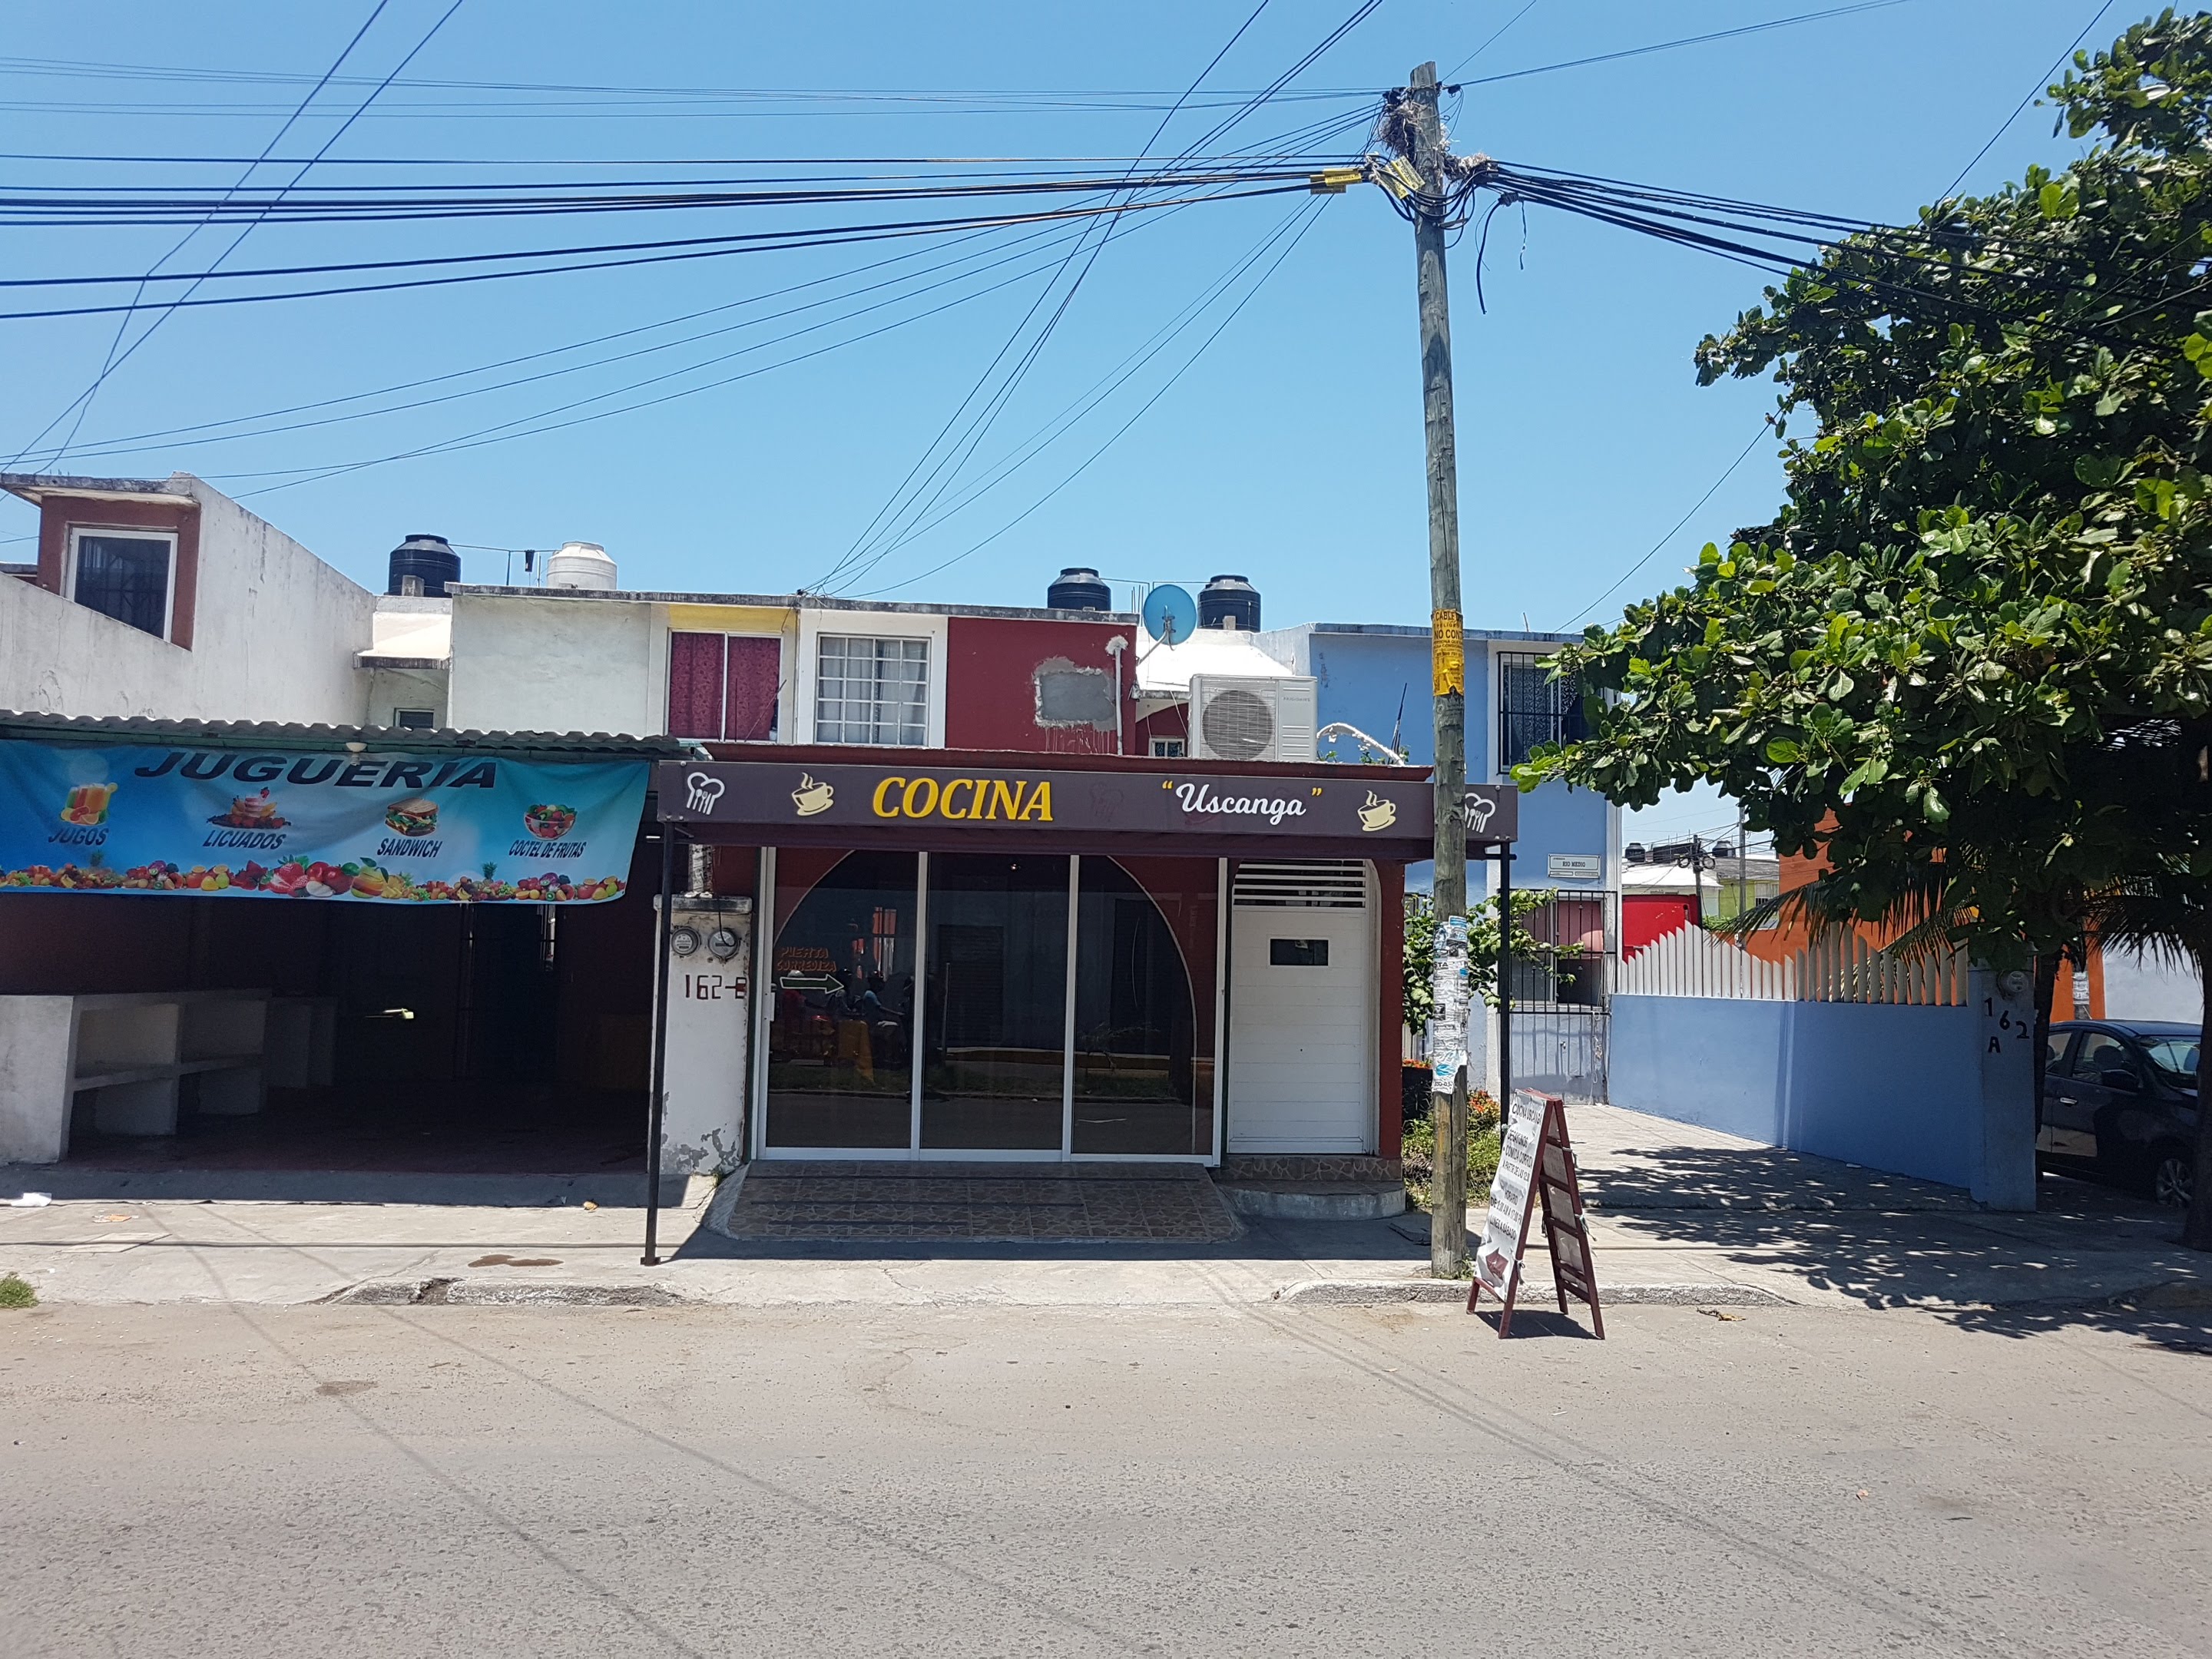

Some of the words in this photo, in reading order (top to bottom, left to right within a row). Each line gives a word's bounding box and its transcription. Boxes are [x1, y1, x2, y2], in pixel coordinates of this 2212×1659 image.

[1434, 629, 1443, 639] NO
[134, 751, 497, 789] JUGUERIA
[873, 777, 1054, 821] COCINA
[48, 827, 109, 846] JUGOS
[202, 830, 287, 850] LICUADOS
[376, 838, 443, 858] SANDWICH
[508, 839, 543, 857] COCTEL
[540, 843, 557, 858] DE
[553, 842, 587, 858] FRUTAS
[781, 945, 829, 959] PUERTA
[777, 959, 837, 972] CORREDIZA
[1988, 1036, 2001, 1053] A
